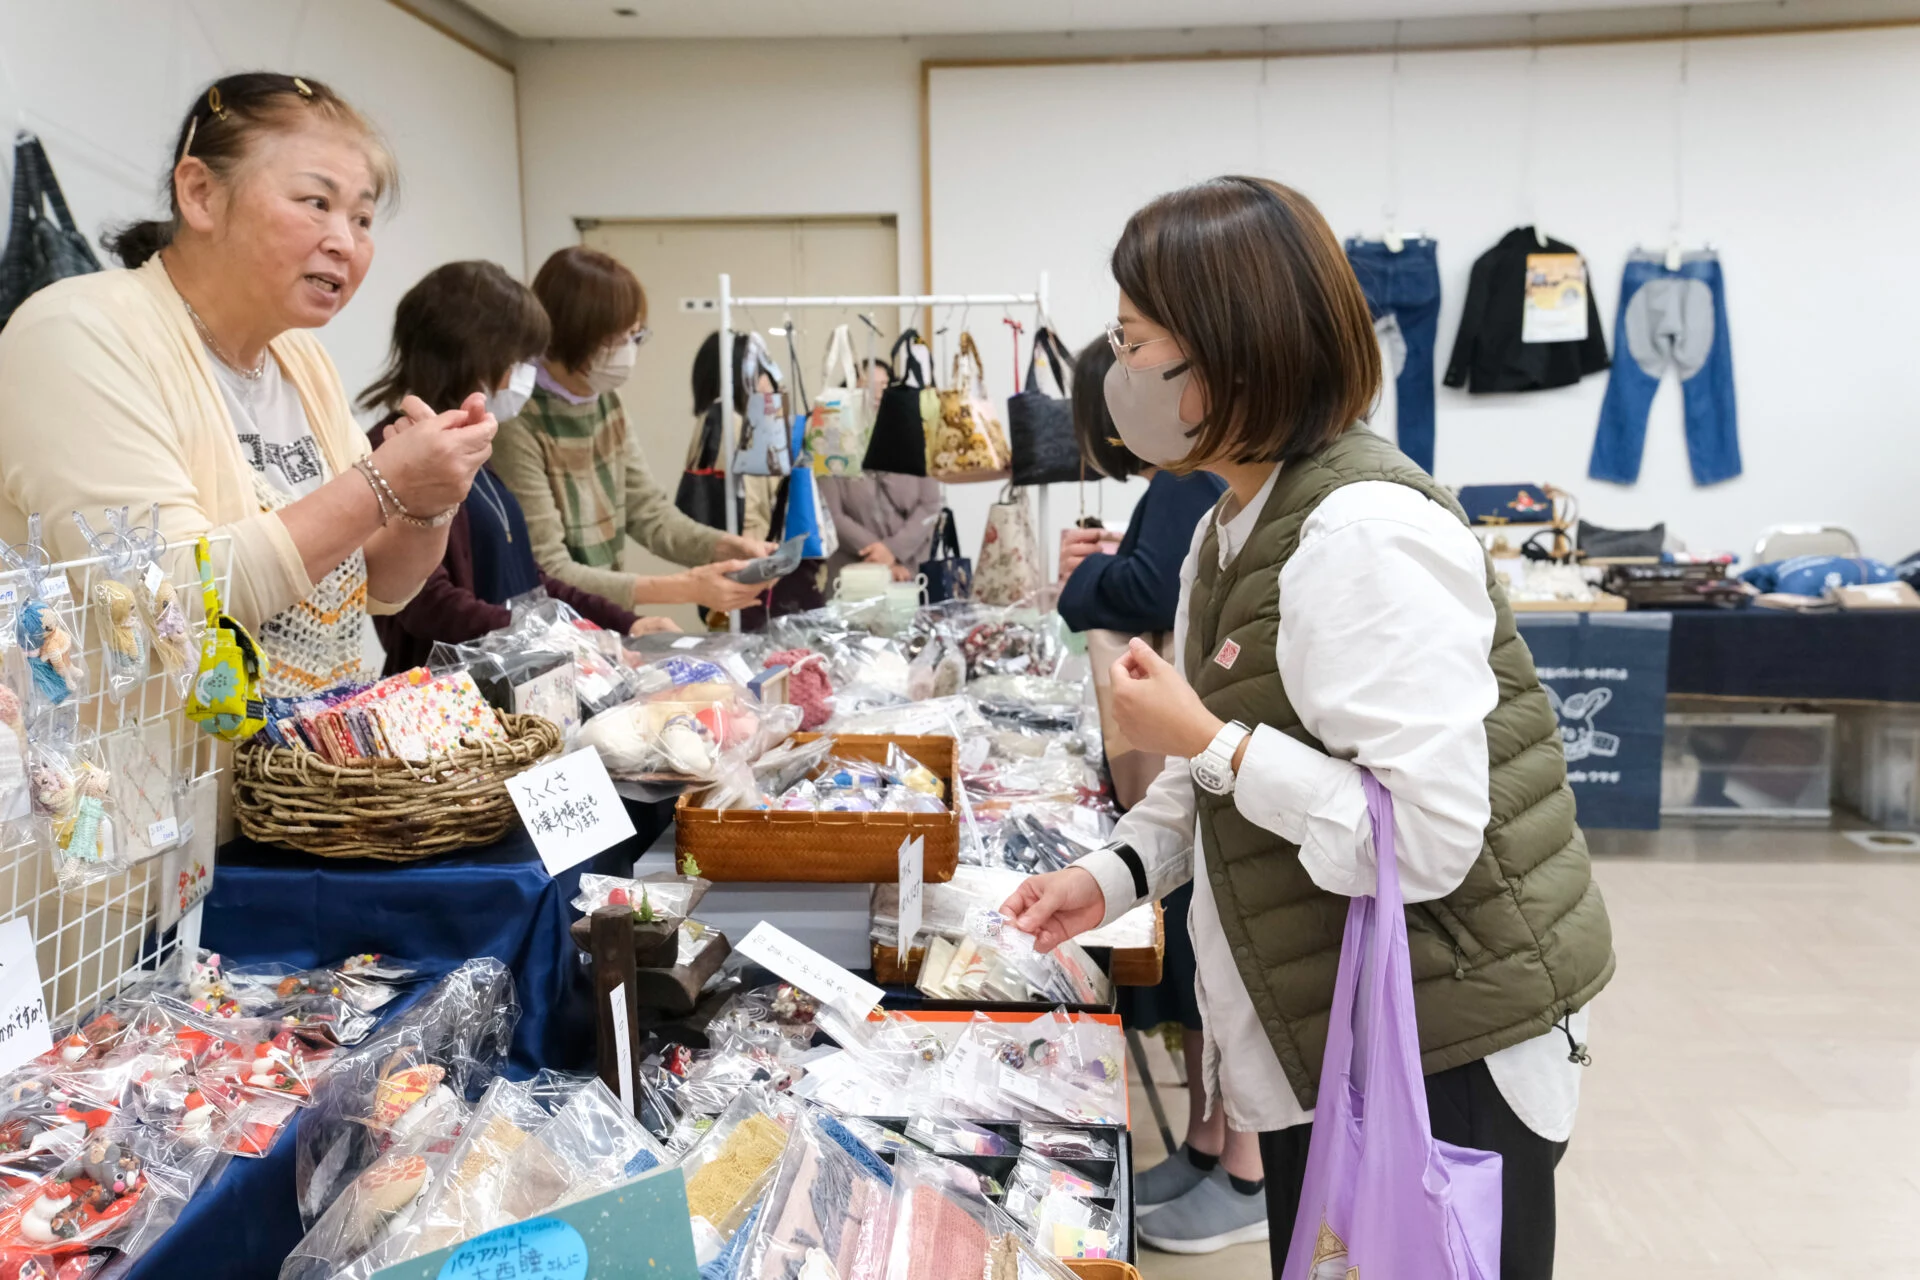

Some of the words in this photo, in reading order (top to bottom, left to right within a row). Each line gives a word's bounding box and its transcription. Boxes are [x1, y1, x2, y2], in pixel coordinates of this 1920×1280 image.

[522, 771, 569, 808] ふくさ
[450, 1236, 530, 1275] パラアスリート
